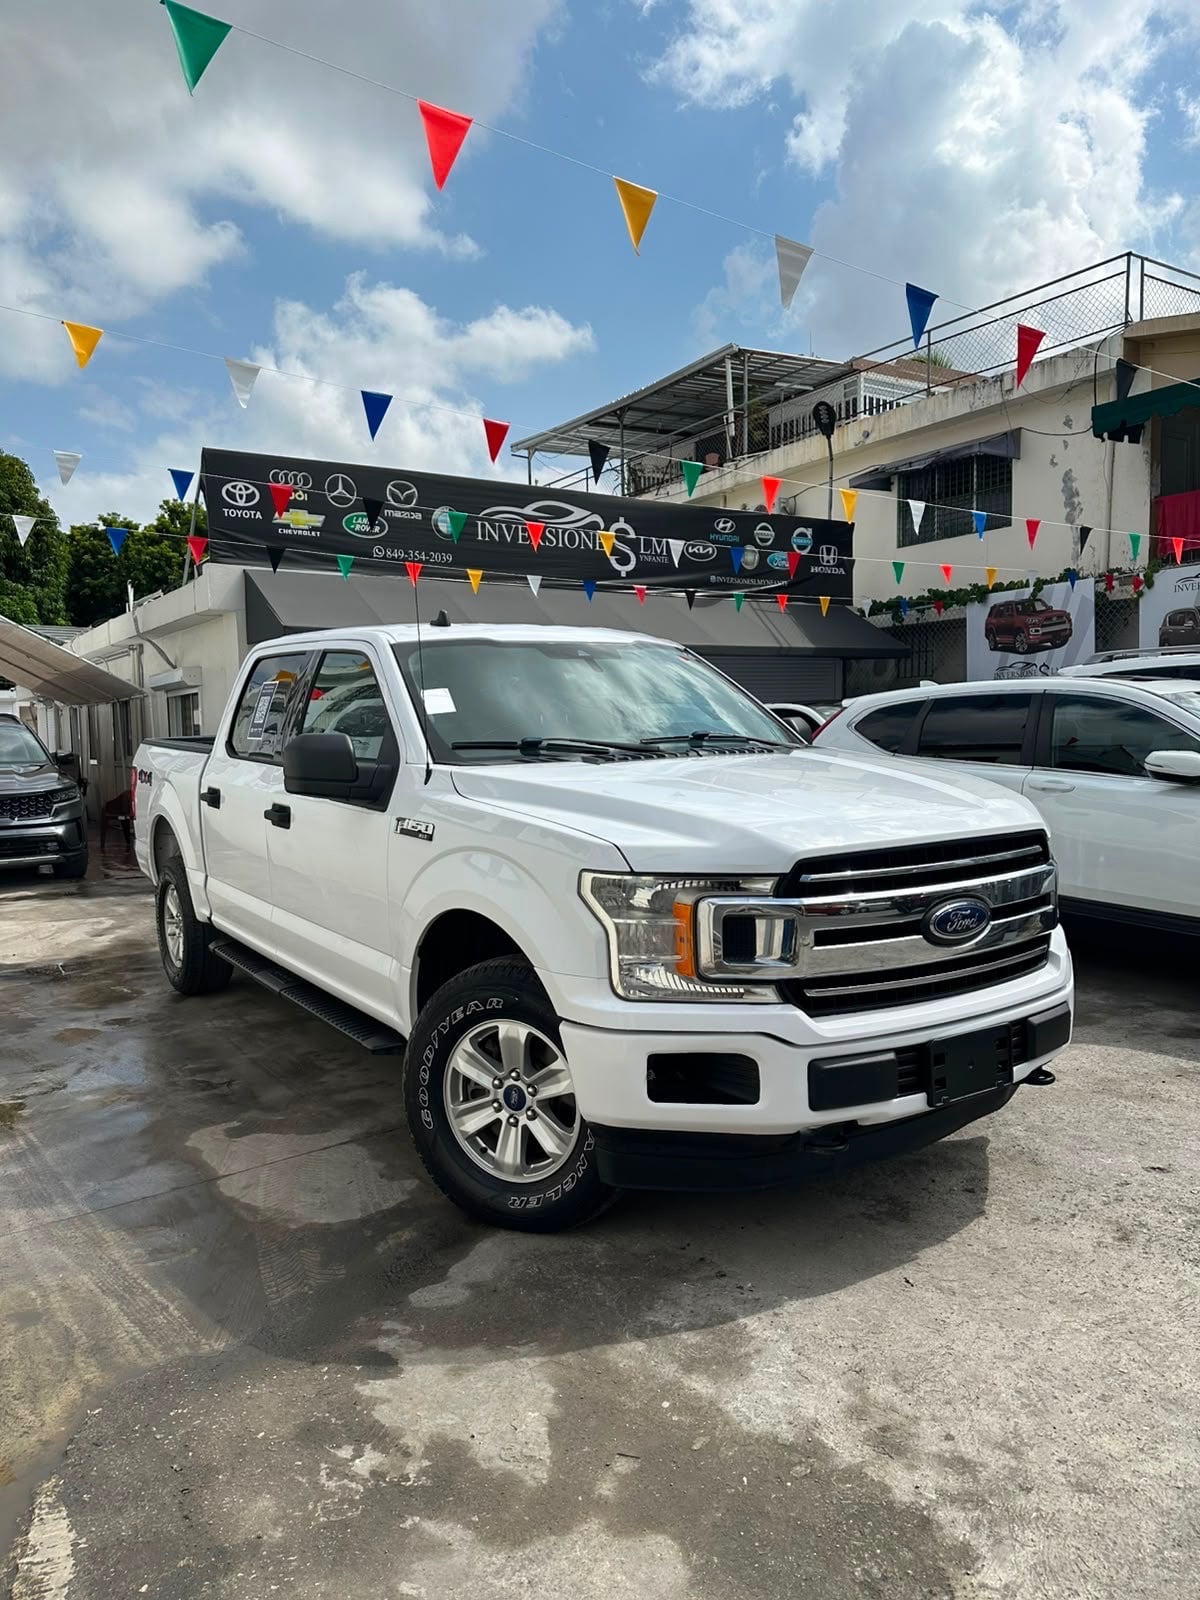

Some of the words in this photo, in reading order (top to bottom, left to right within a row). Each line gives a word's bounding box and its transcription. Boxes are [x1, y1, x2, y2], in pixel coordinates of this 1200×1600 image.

[222, 508, 263, 520] TOYOTA
[278, 528, 321, 537] CHEVROLET
[355, 525, 381, 535] ROVR
[385, 547, 453, 564] 849-354-2039
[810, 565, 846, 575] HONDA
[946, 909, 979, 932] Ford
[419, 997, 504, 1130] GOODYEAR
[507, 1127, 596, 1209] ANGLER
